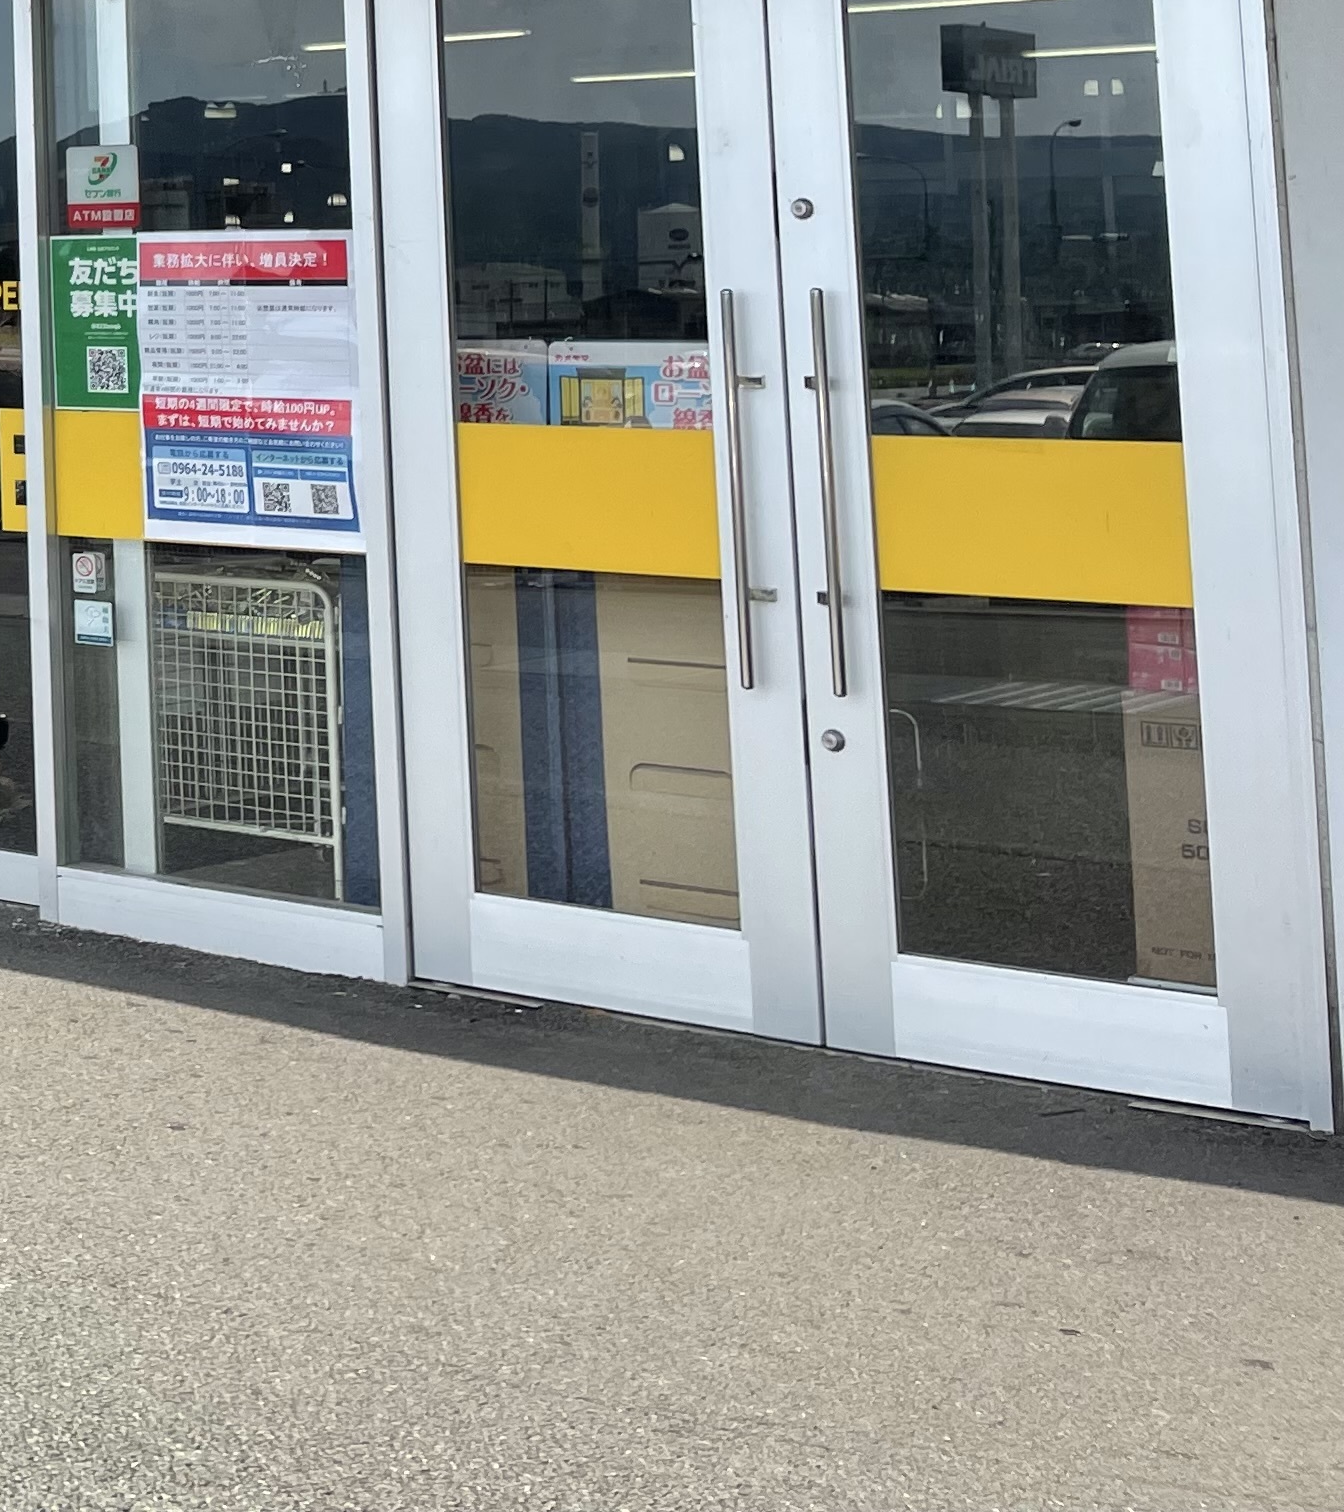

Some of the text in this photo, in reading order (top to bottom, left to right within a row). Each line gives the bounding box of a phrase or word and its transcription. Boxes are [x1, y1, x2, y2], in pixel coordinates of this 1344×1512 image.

[68, 256, 137, 286] 友だち
[69, 289, 137, 319] 募集中
[1188, 819, 1208, 835] S
